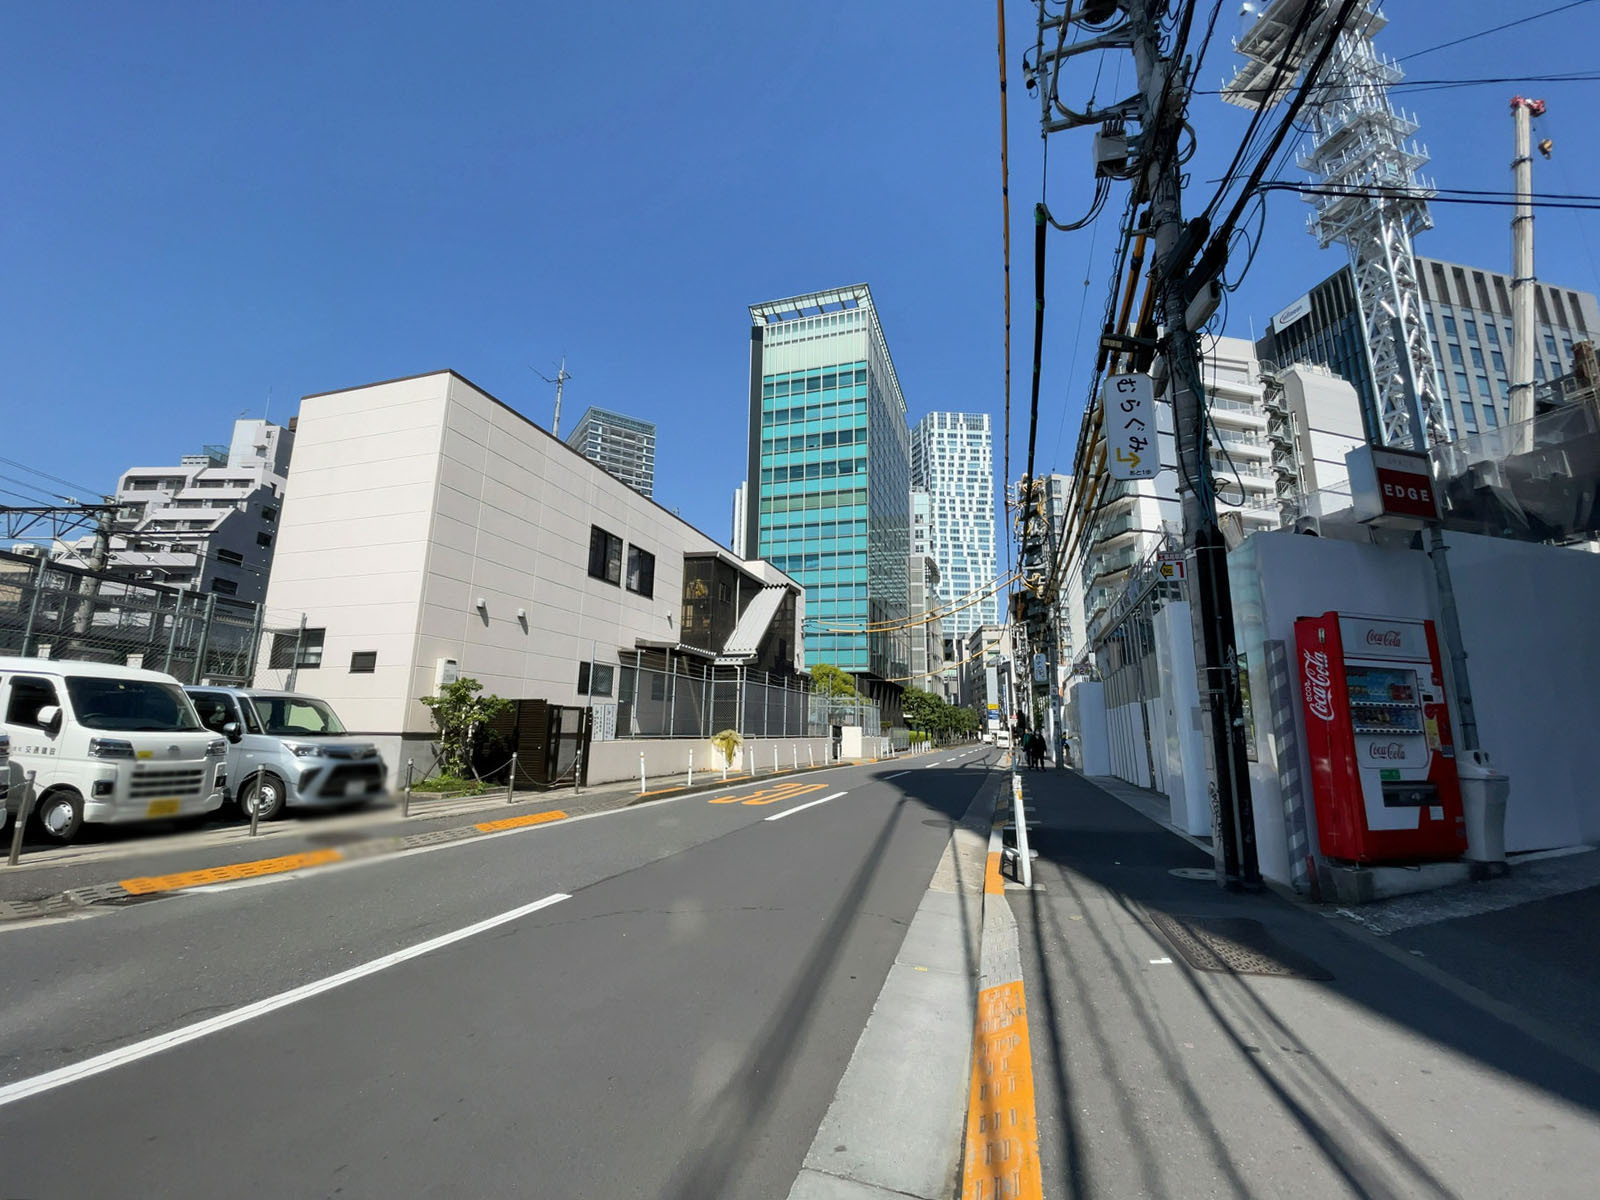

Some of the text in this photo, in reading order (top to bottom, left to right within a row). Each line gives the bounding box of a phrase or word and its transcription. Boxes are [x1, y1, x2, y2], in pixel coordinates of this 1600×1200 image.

[1117, 378, 1149, 453] むらぐみ
[1384, 484, 1430, 502] EDGE
[1176, 561, 1185, 578] 1
[1304, 648, 1335, 721] Coca-Cola
